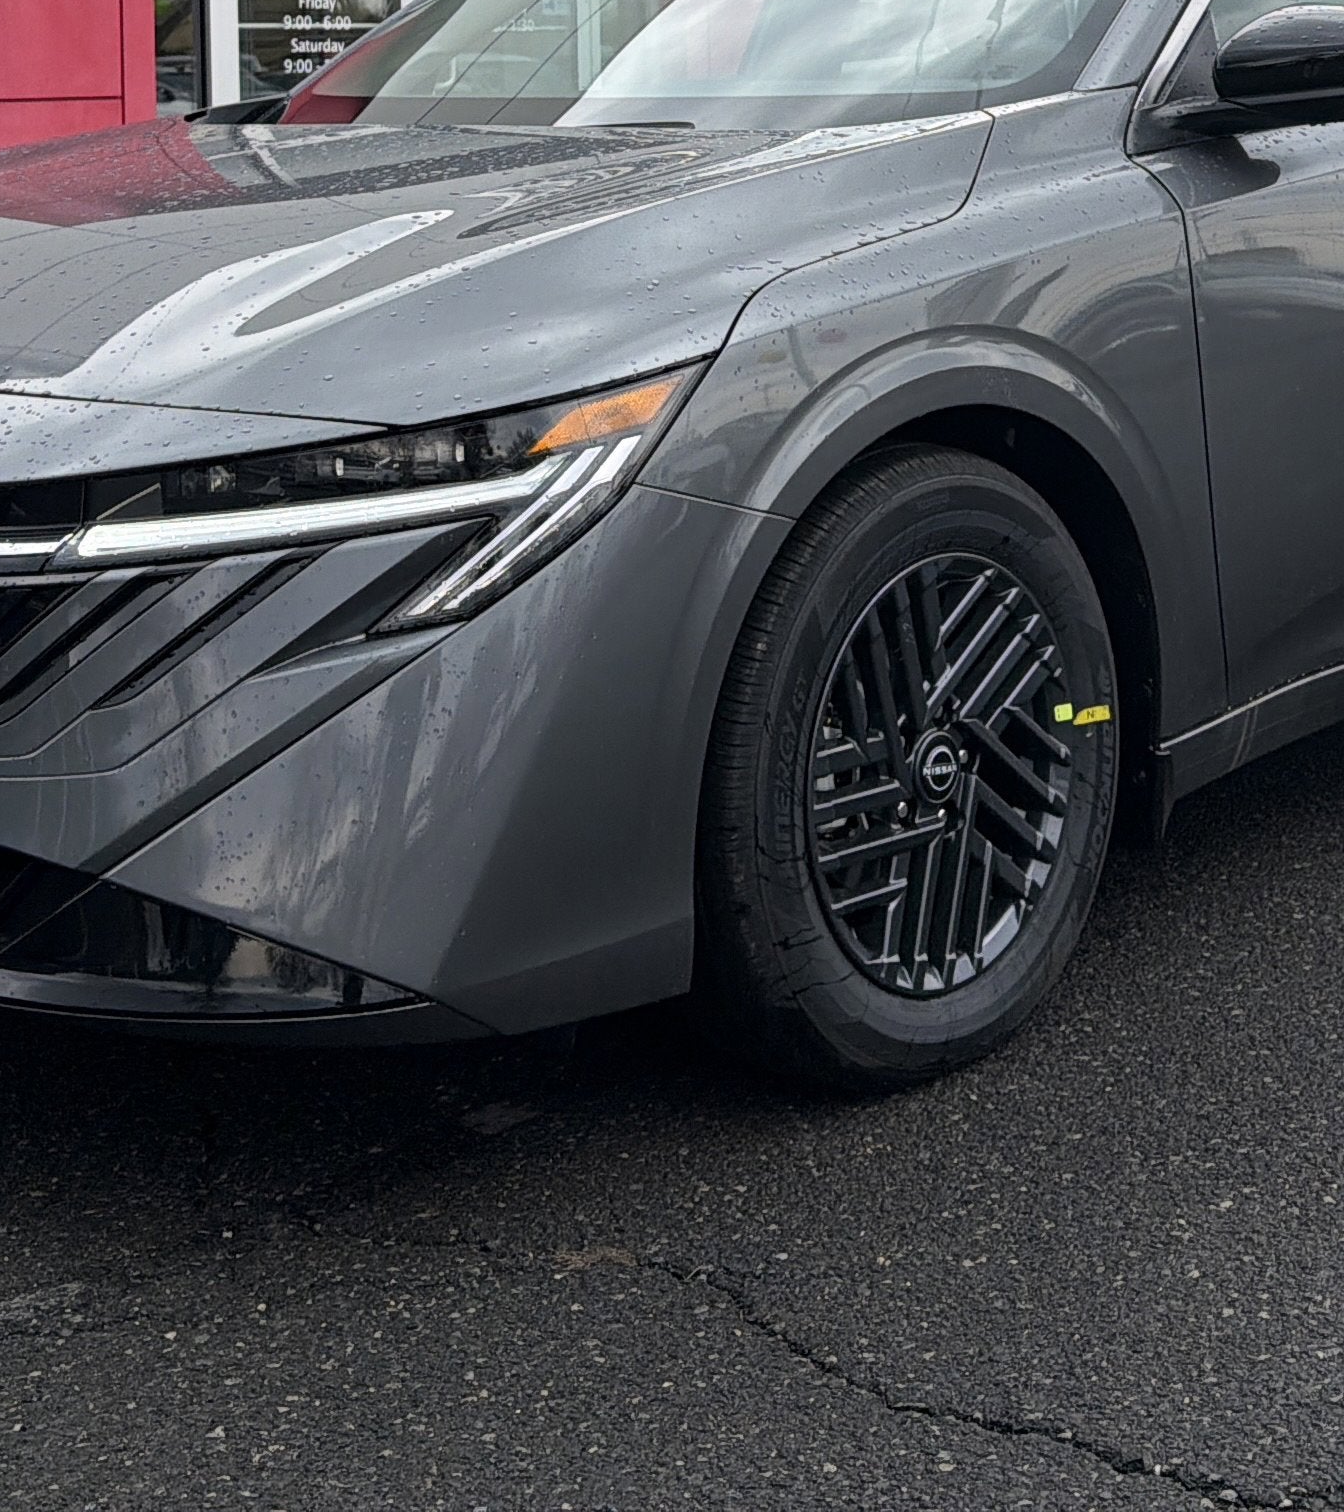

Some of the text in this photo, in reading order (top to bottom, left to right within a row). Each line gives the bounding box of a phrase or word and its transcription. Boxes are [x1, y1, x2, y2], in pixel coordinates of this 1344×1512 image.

[283, 14, 313, 31] 9:00
[323, 15, 352, 31] 6:00
[290, 37, 346, 54] Saturday
[283, 58, 313, 74] 9:00
